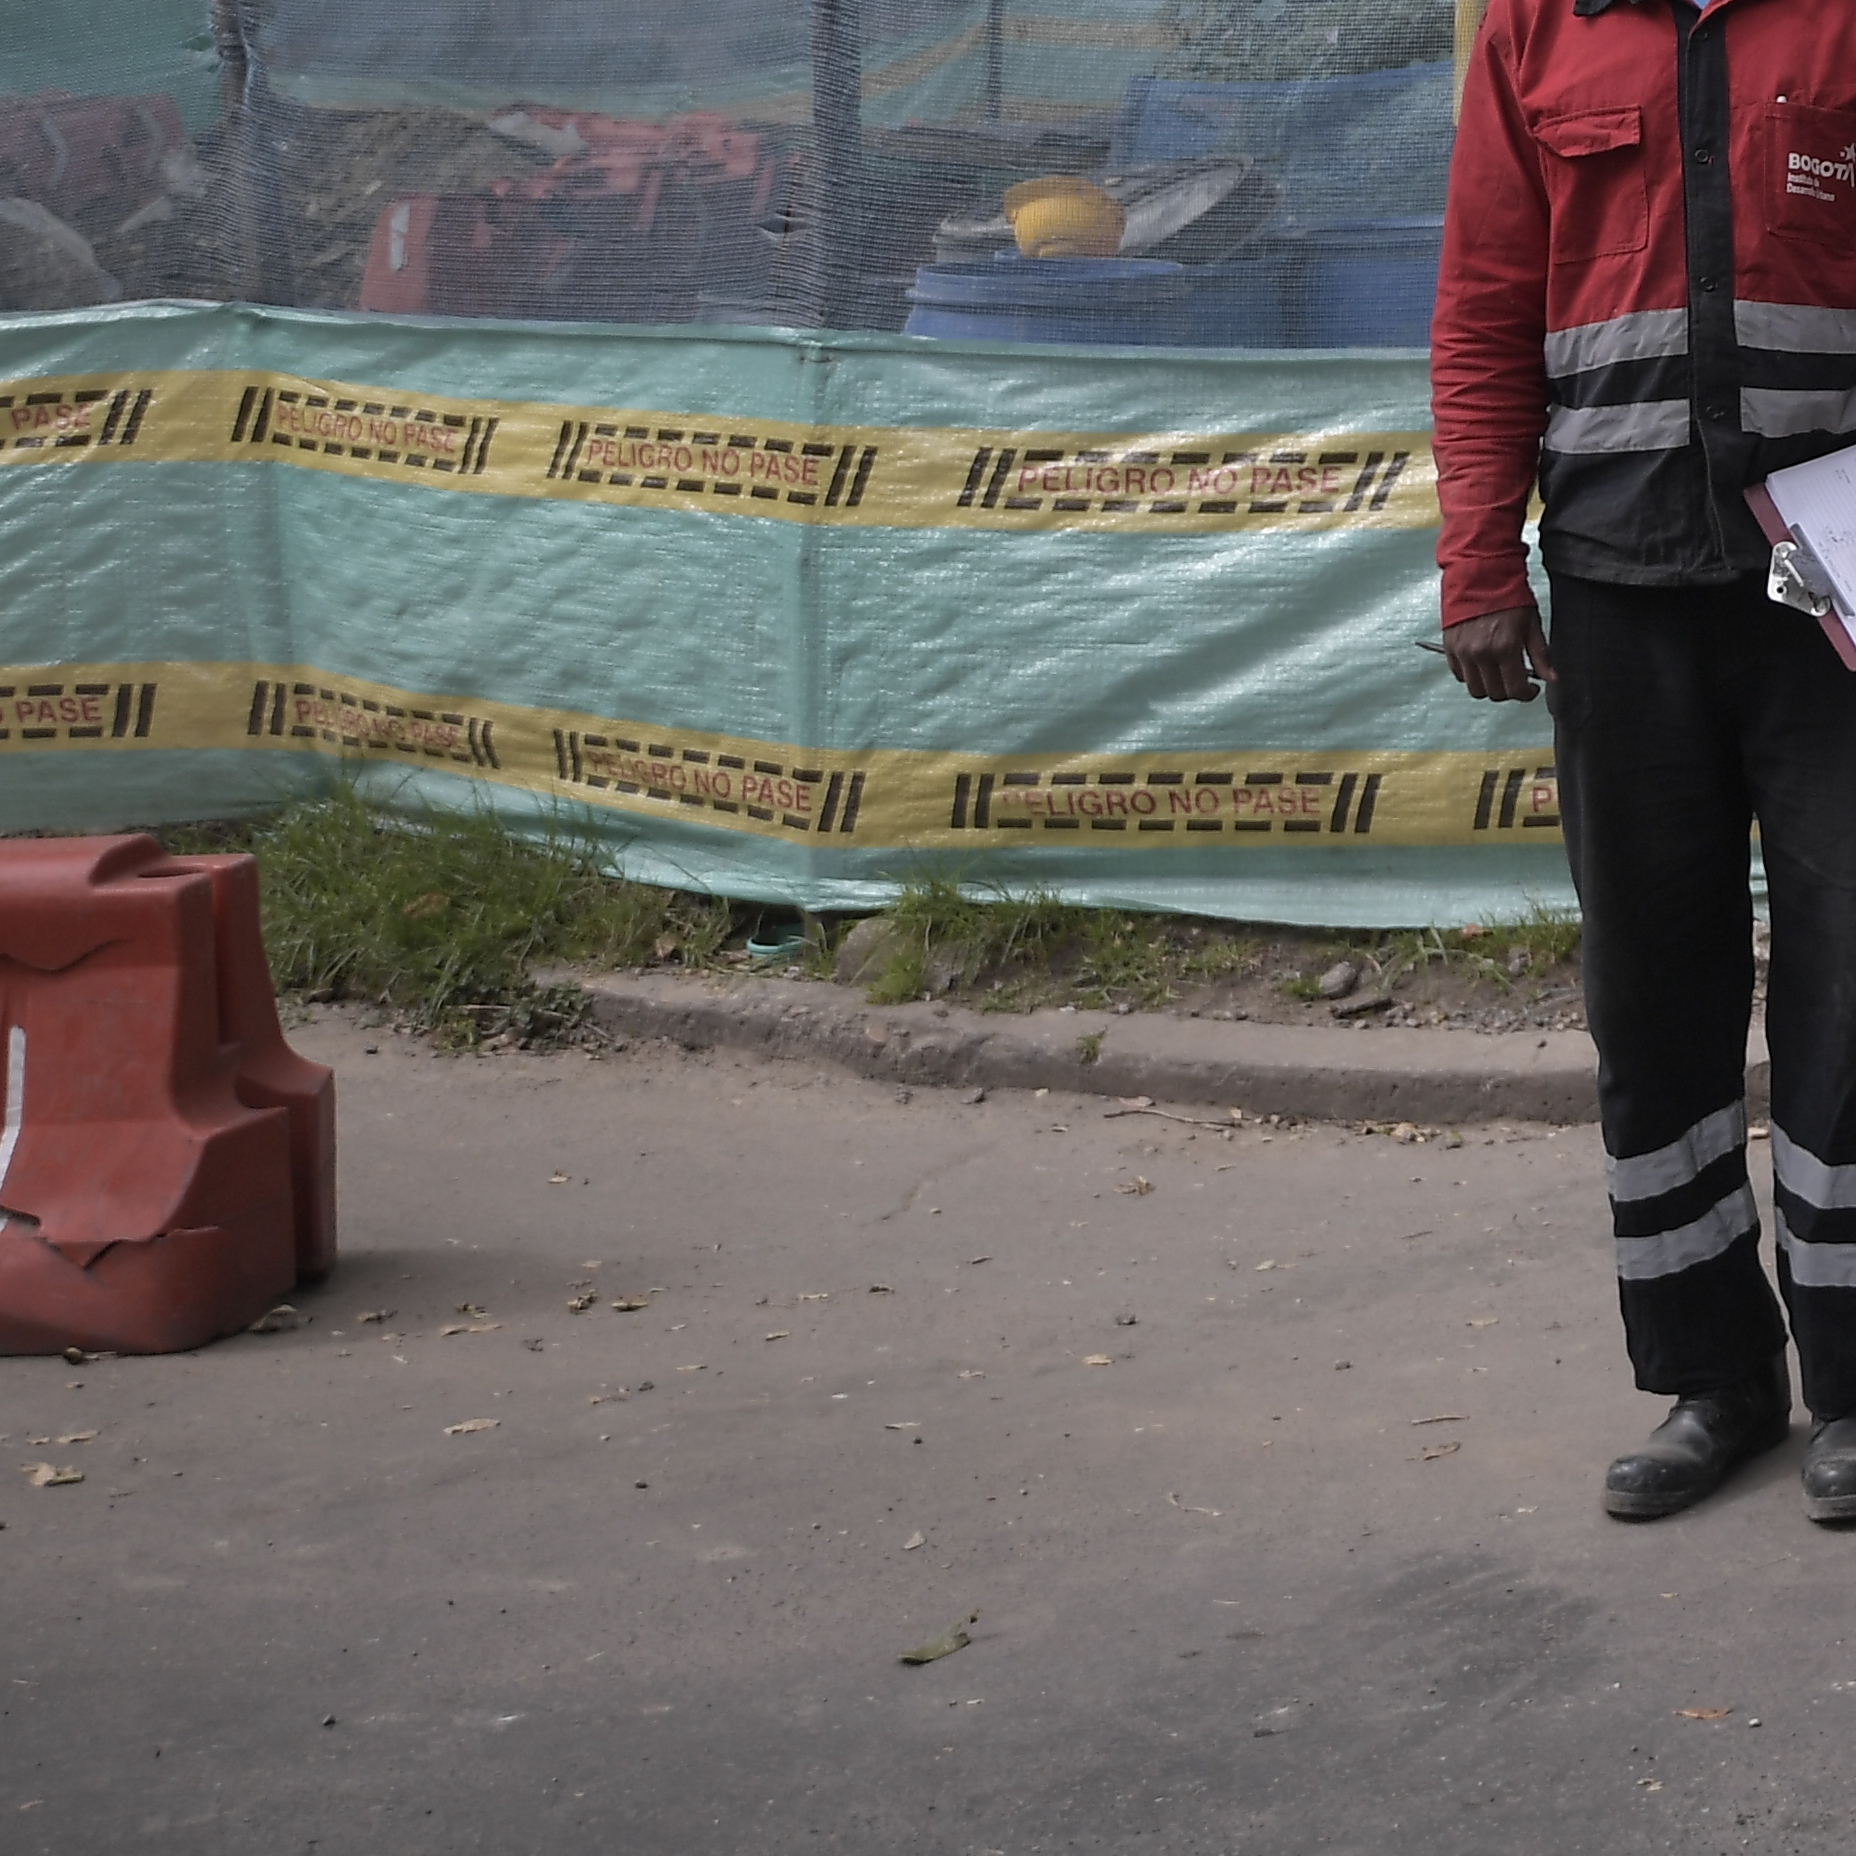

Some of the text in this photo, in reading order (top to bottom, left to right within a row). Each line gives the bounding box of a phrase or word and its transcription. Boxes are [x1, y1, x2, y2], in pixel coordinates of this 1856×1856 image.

[11, 402, 91, 431] PASE
[276, 404, 460, 454] PELIGRO NO PASE
[587, 438, 819, 486] PELIGRO NO PASE
[1017, 465, 1344, 497] PELIGRO NO PASE
[15, 697, 102, 723] PASE
[586, 748, 812, 812] PELIGRO NO PASE
[1169, 788, 1220, 817] NO
[1232, 786, 1322, 817] PASE
